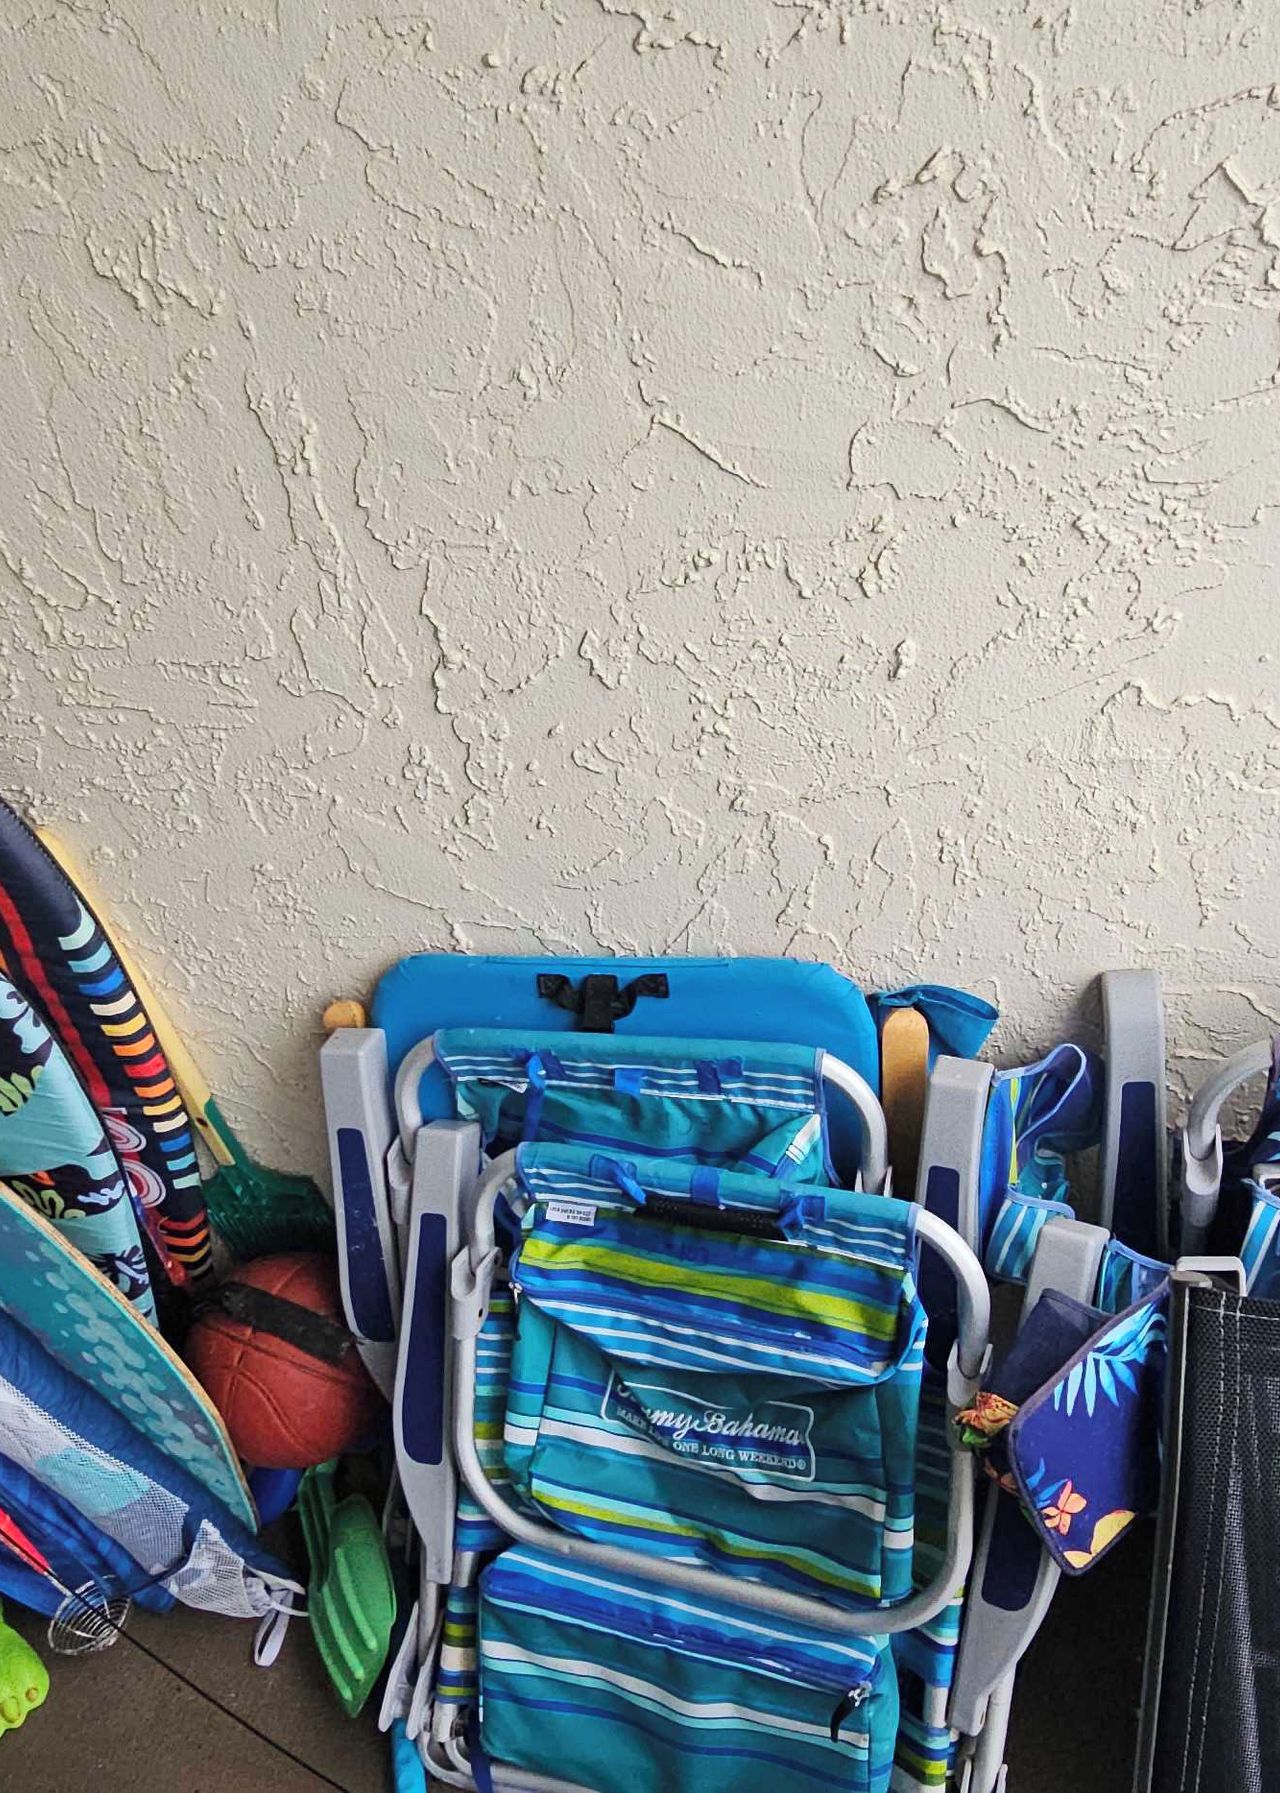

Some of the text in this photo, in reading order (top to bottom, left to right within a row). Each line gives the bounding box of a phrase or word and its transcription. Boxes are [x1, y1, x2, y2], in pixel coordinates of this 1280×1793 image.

[695, 1410, 801, 1446] Bahama
[672, 1441, 699, 1454] ONE
[701, 1445, 734, 1460] LONG
